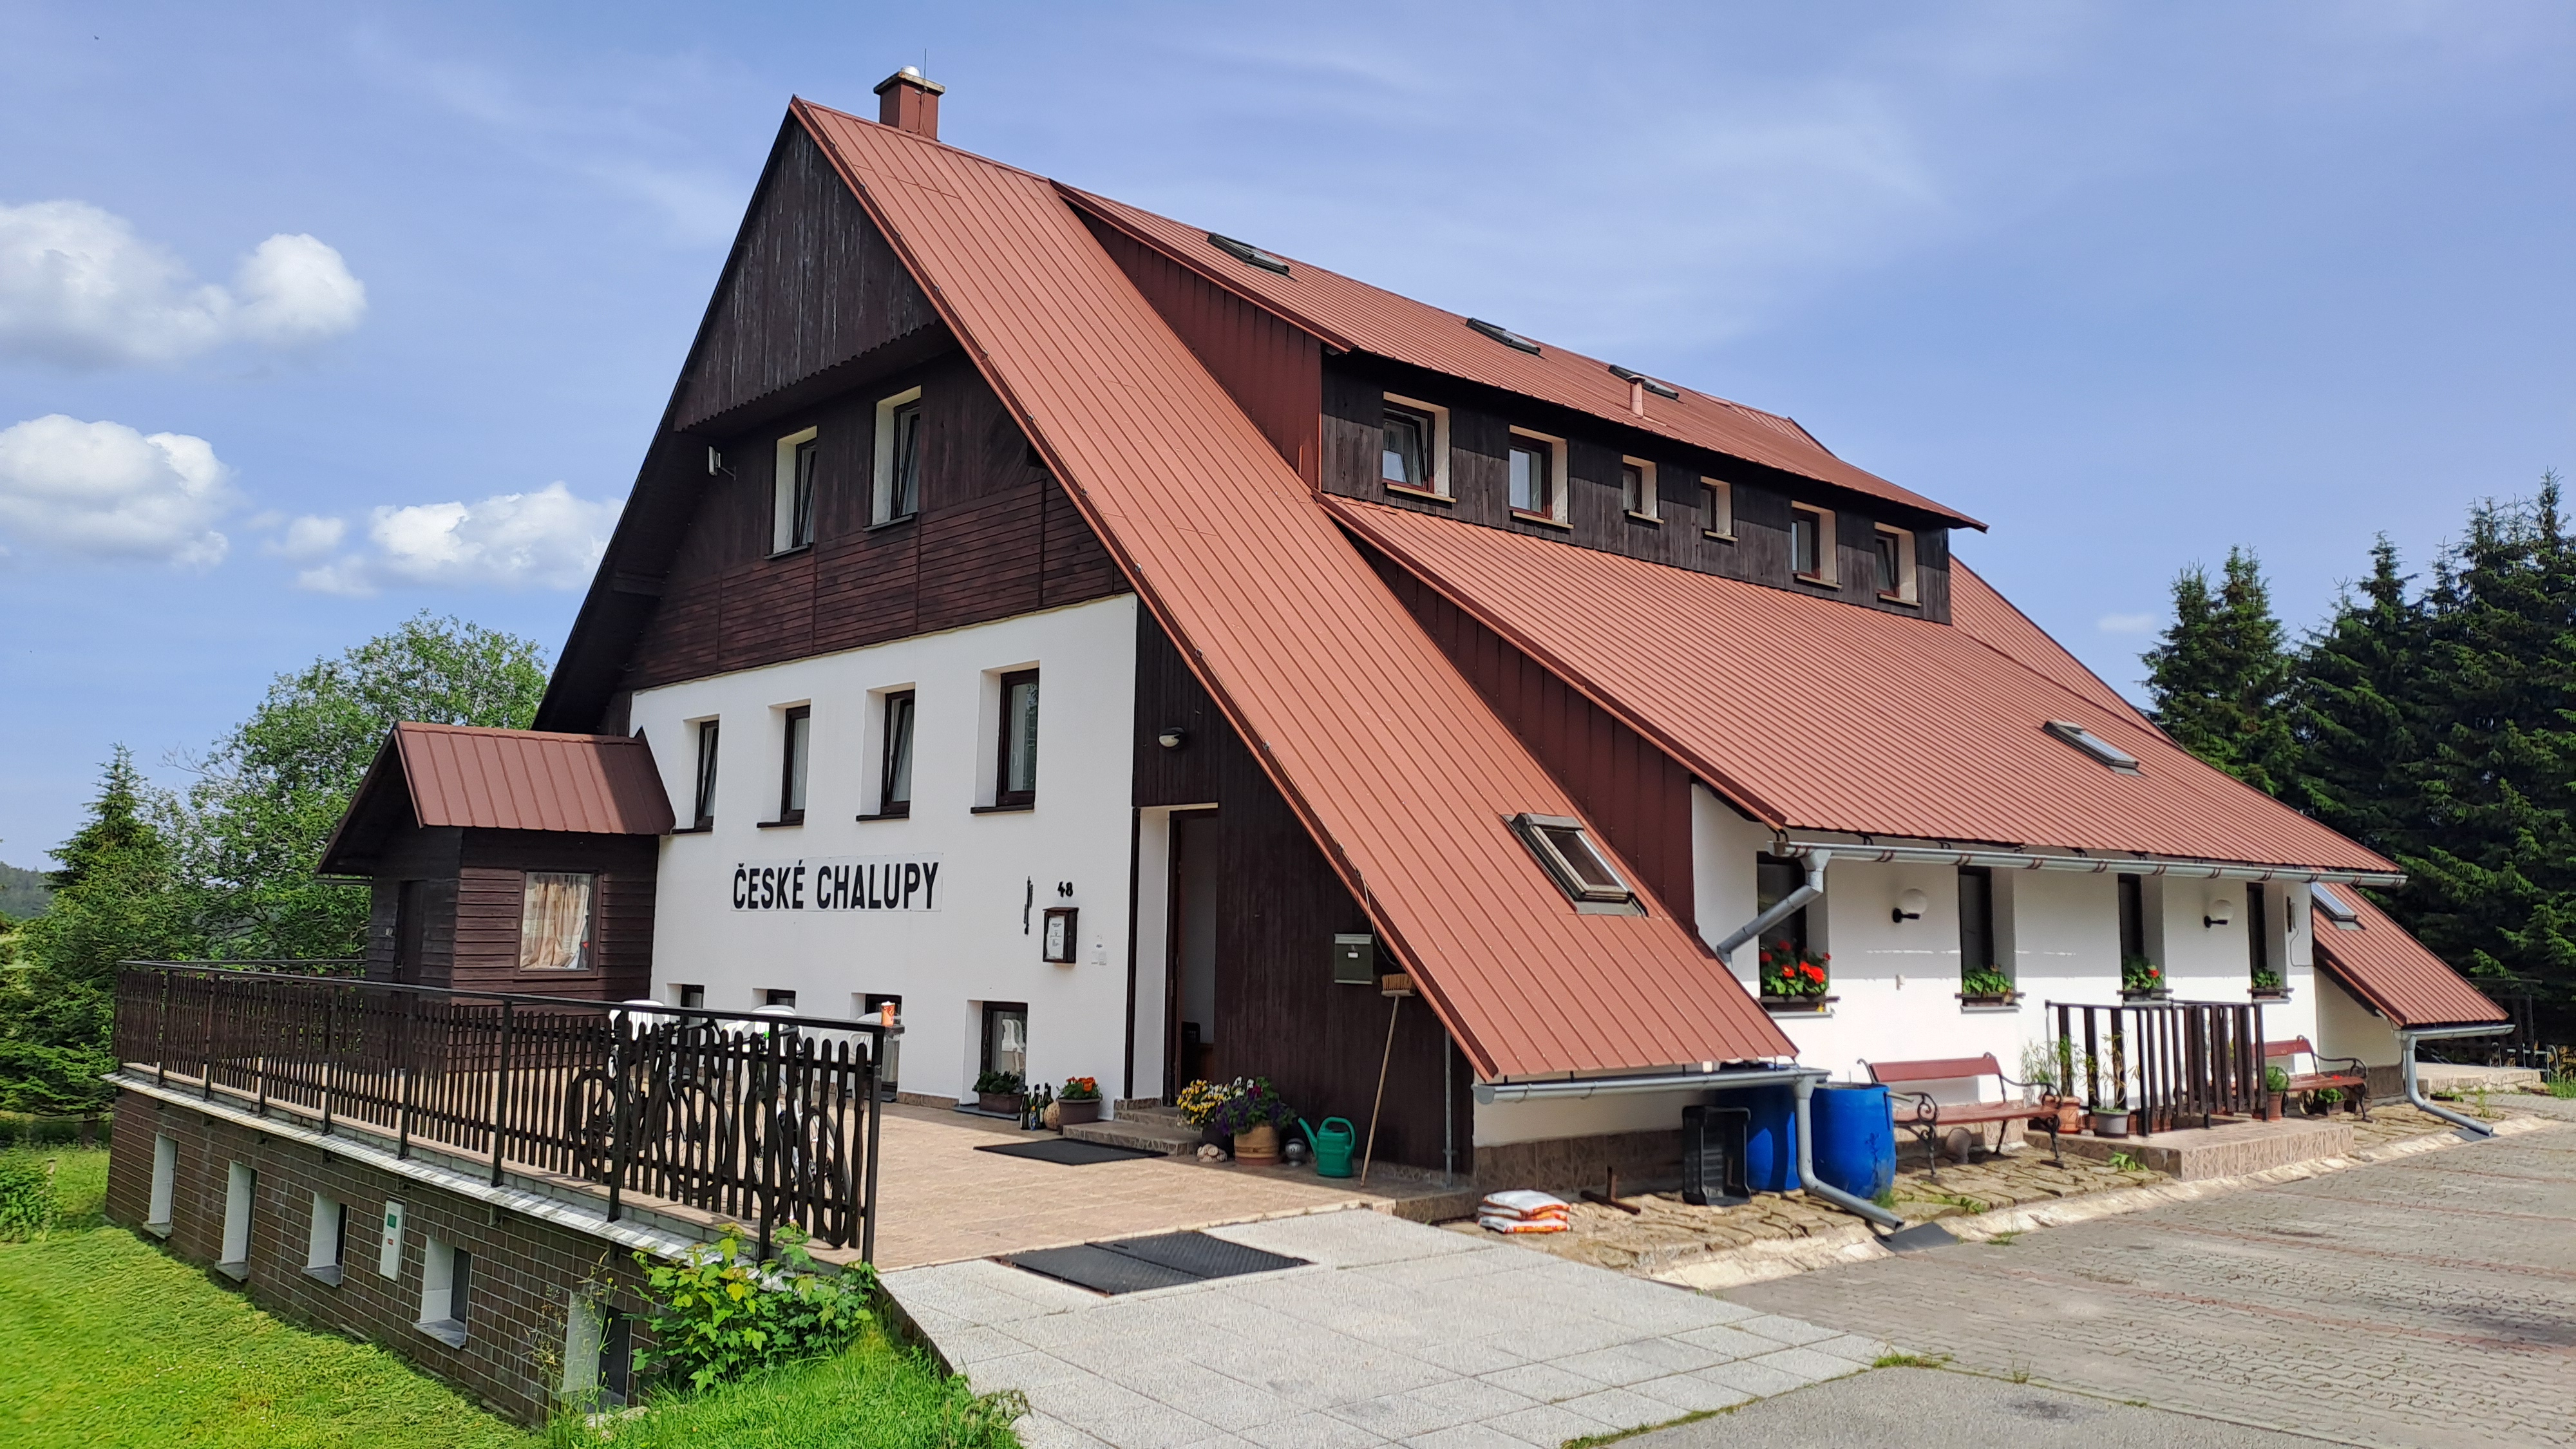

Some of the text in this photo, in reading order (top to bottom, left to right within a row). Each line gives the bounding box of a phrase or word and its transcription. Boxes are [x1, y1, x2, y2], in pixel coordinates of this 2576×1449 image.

[733, 859, 939, 909] ČESKÉ CHALUPY
[1057, 881, 1074, 898] 48
